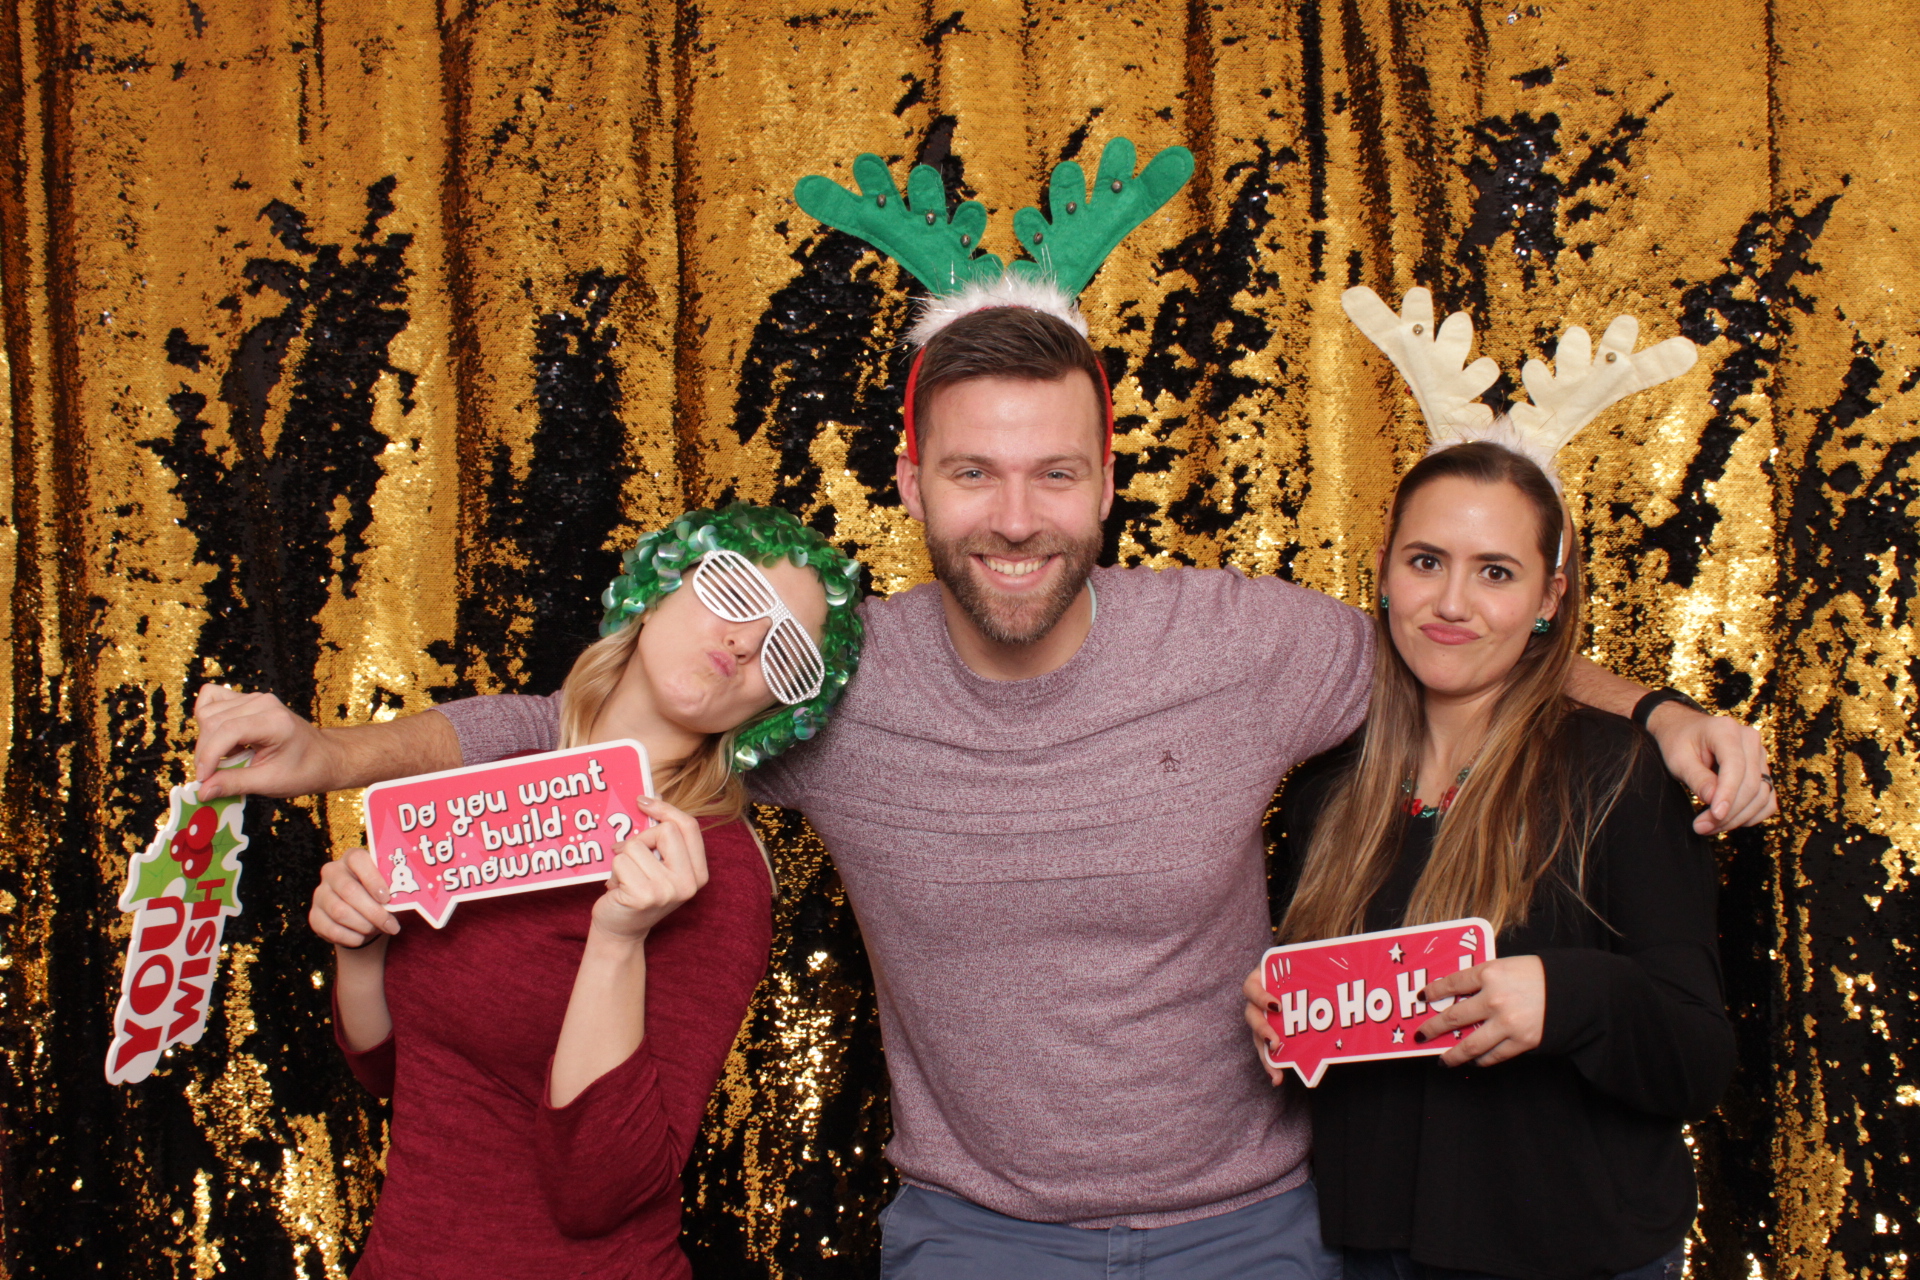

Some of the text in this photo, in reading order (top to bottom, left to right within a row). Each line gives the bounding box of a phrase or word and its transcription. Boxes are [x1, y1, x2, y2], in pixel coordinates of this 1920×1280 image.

[398, 759, 606, 836] Do you want
[419, 805, 597, 866] to build a
[442, 839, 603, 892] snowman
[112, 895, 186, 1075] YOU
[165, 878, 226, 1043] WISH
